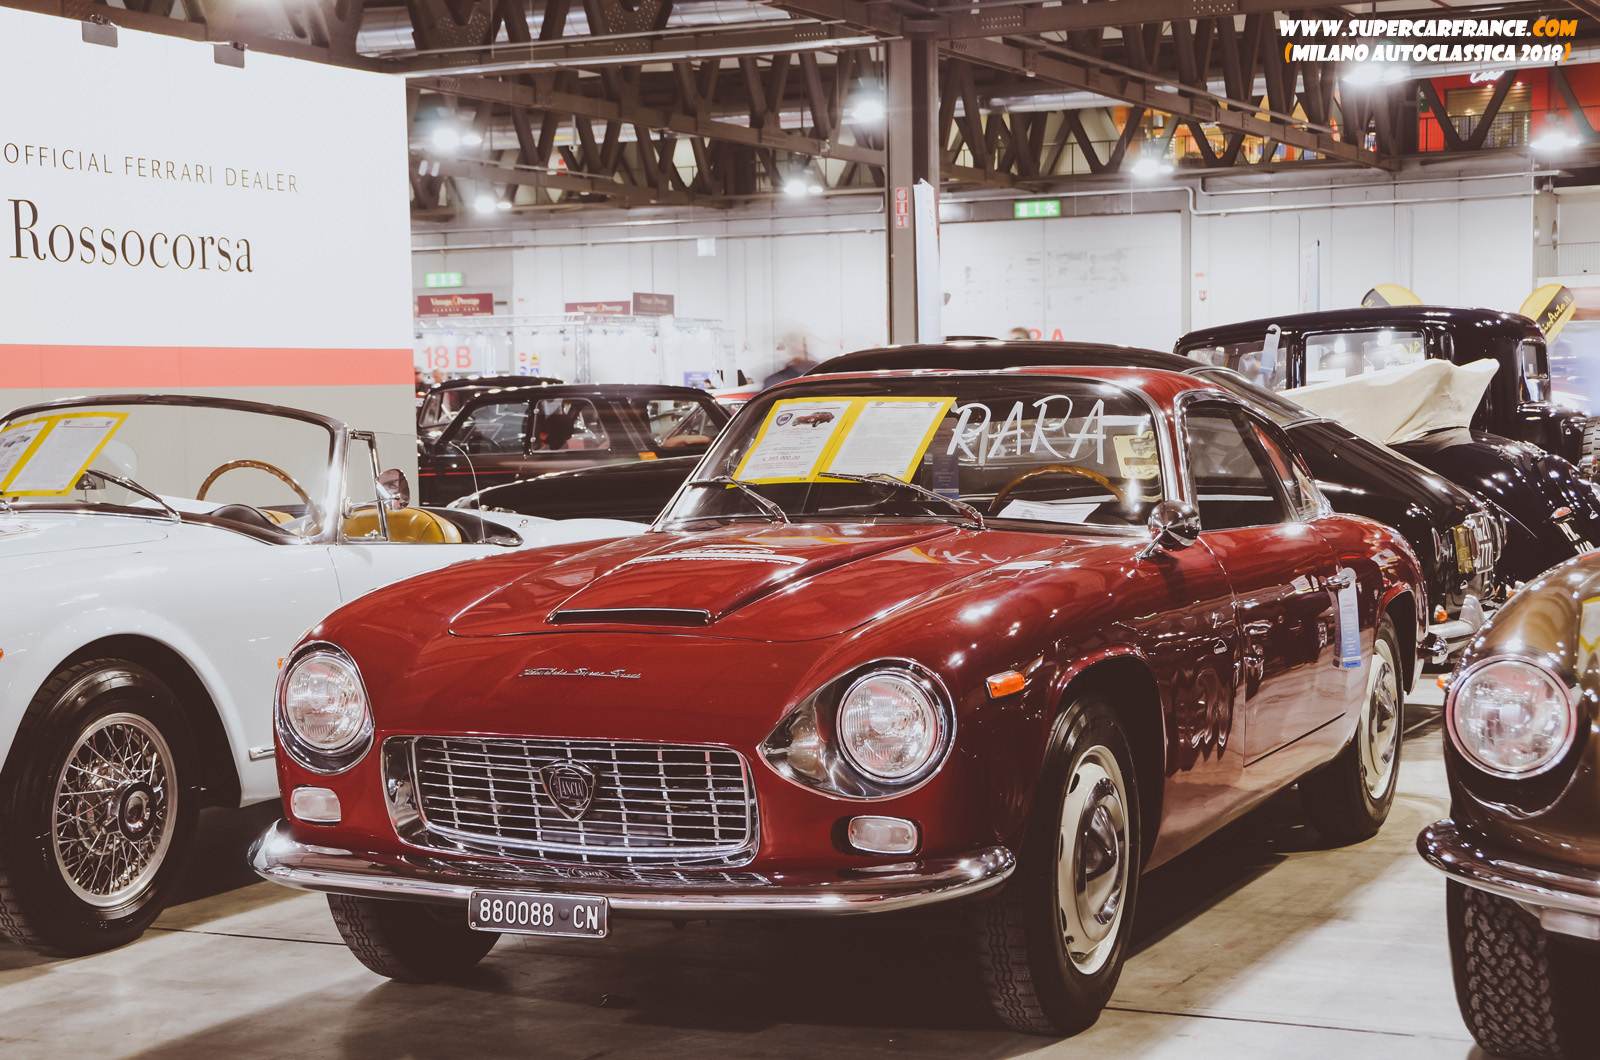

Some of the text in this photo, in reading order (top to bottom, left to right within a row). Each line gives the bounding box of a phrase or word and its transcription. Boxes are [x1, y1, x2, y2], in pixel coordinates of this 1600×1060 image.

[3, 142, 299, 193] OFFICIAL FERRARI DEALER
[8, 198, 254, 273] Rossocorsa
[422, 345, 472, 369] 18 B
[479, 898, 599, 930] 880088 CN
